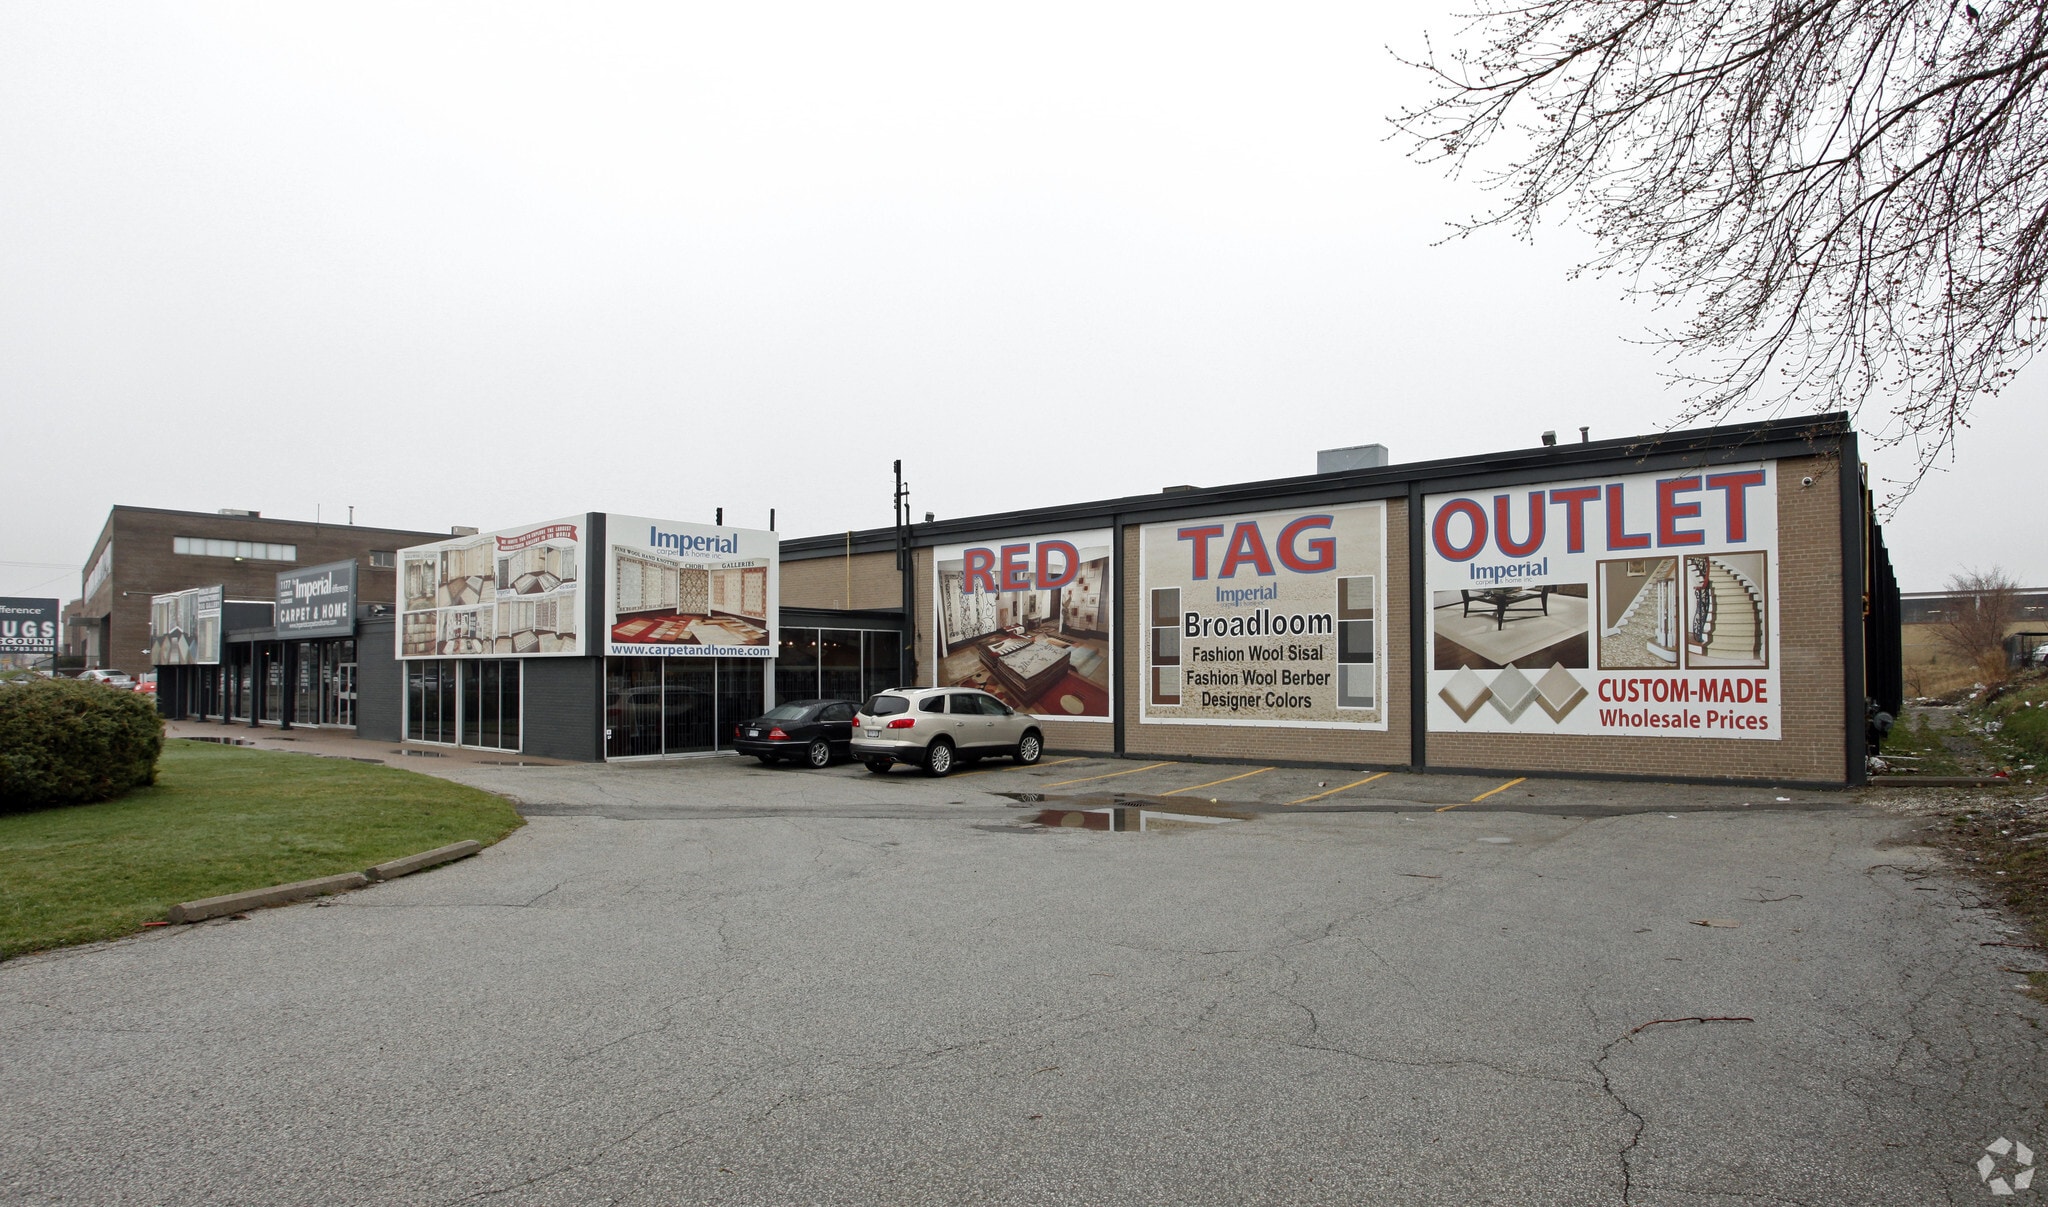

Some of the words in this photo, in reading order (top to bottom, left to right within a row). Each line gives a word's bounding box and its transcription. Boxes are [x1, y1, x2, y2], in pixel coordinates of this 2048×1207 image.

[1432, 470, 1766, 562] OUTLET
[650, 526, 738, 556] Imperial
[1177, 515, 1336, 580] TAG
[627, 549, 641, 557] WOOL
[642, 553, 655, 561] HAND
[657, 557, 679, 567] KNOTTED
[657, 549, 679, 557] carpet
[722, 561, 755, 569] GALLERIES
[962, 540, 1080, 594] RED
[1470, 557, 1547, 584] Imperial
[280, 580, 291, 590] 1177
[296, 572, 332, 604] Imperial
[1216, 582, 1277, 607] Imperial
[280, 607, 310, 623] CARPET
[313, 607, 318, 619] &
[322, 602, 347, 619] HOME
[2, 620, 55, 637] UGS
[1184, 609, 1332, 638] Broadloom
[611, 645, 770, 656] www.carpetandhome.com
[1193, 647, 1244, 662] Fashion
[1249, 645, 1283, 661] Wool
[1288, 644, 1323, 661] Sisal
[1186, 670, 1238, 686] Fashion
[1243, 670, 1277, 686] Wool
[1282, 670, 1330, 686] Berber
[1202, 692, 1260, 711] Designer
[1265, 692, 1312, 708] Colors
[1598, 678, 1768, 704] CUSTOM-MADE
[1599, 709, 1700, 729] Wholesale
[1706, 711, 1768, 730] Prices
